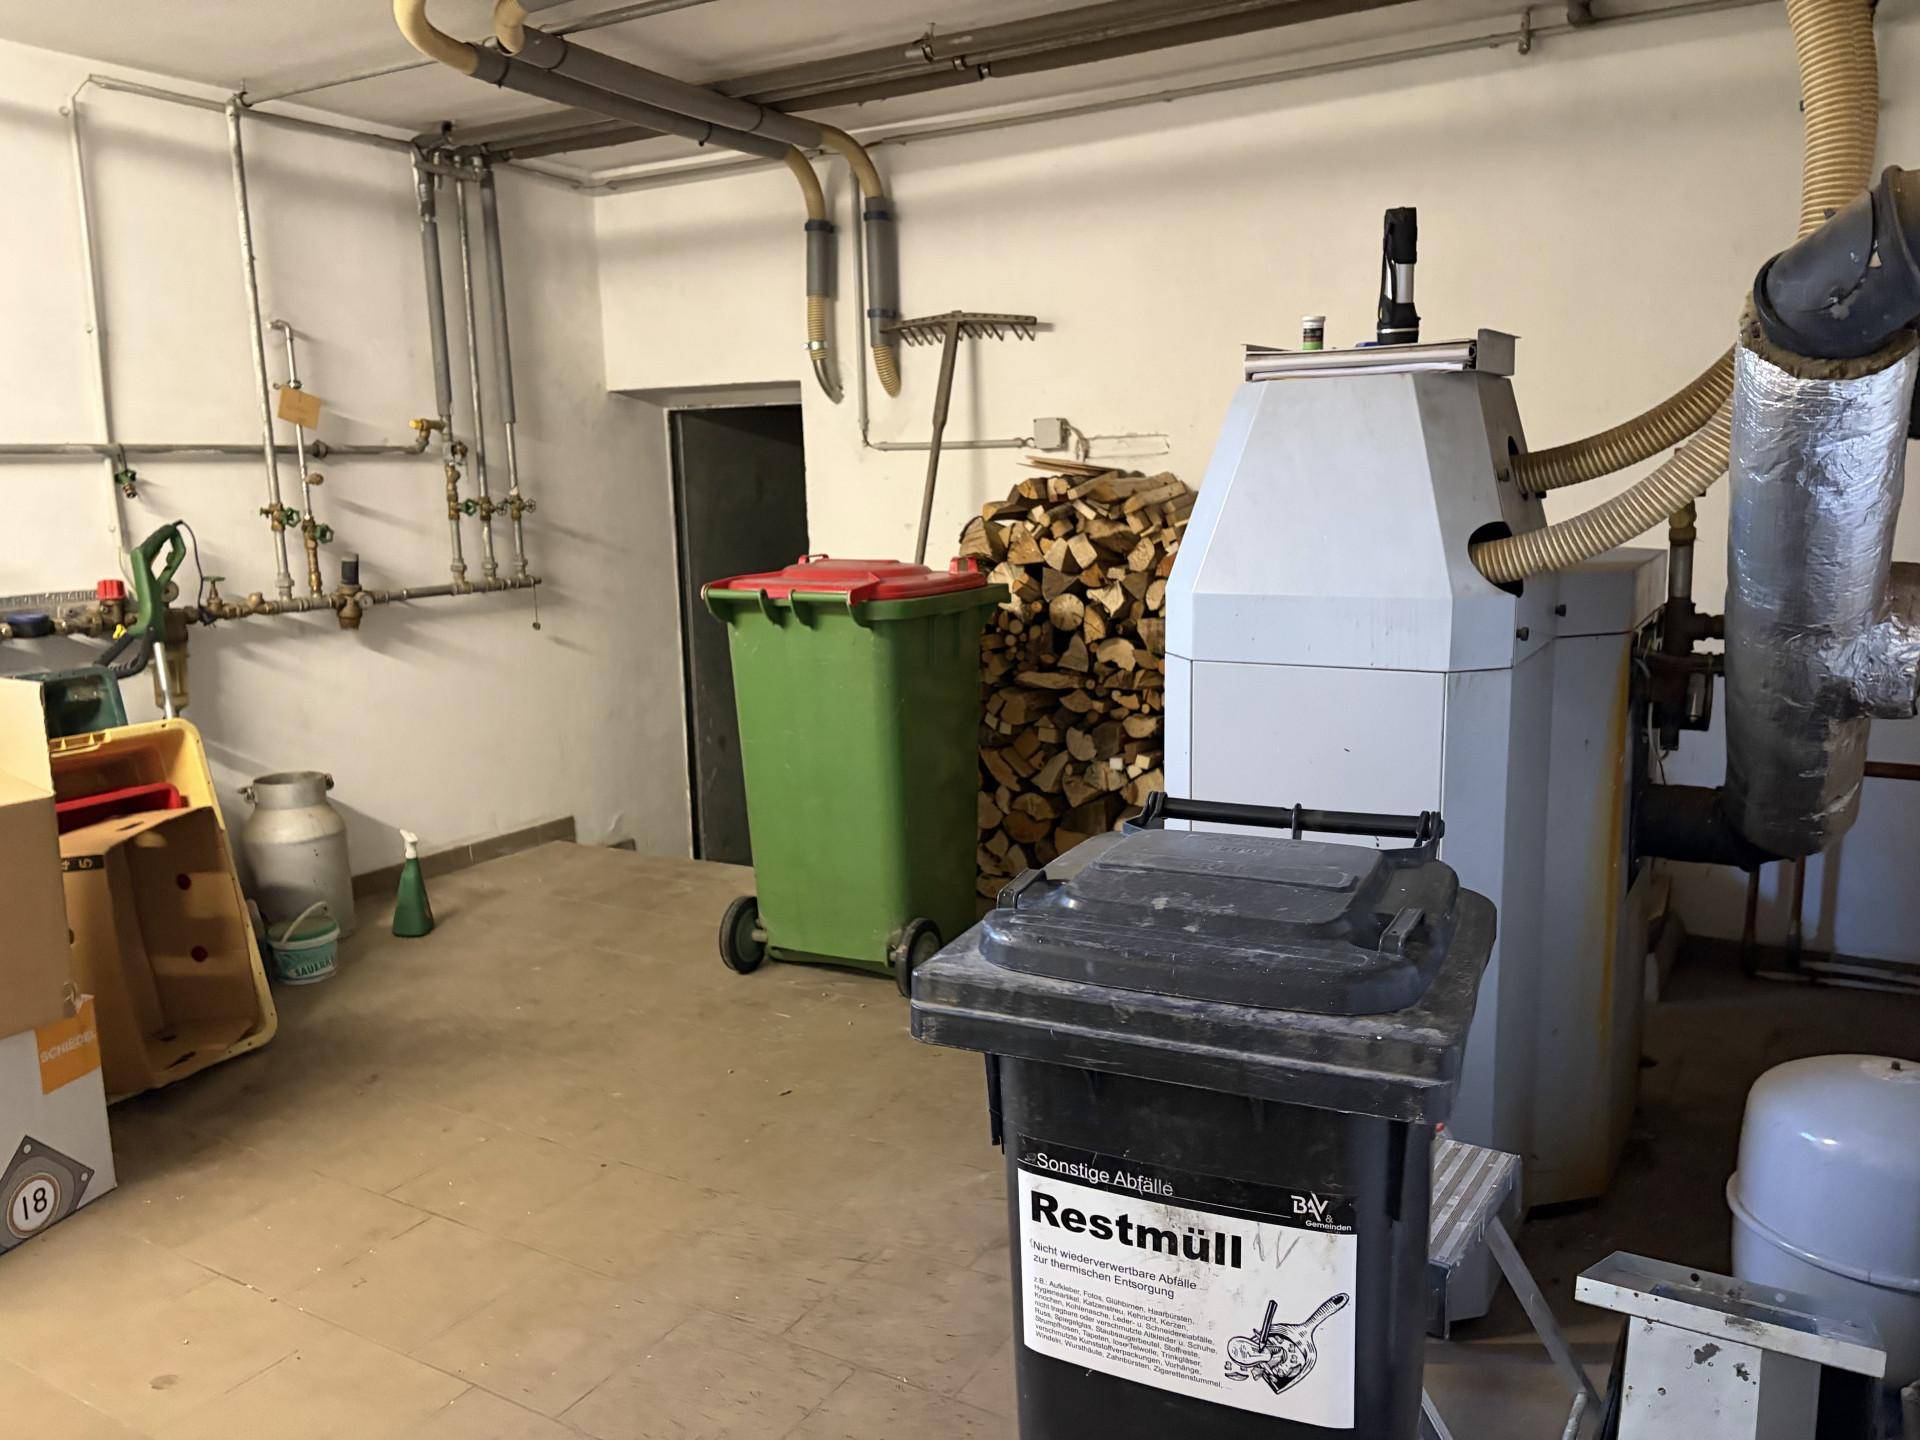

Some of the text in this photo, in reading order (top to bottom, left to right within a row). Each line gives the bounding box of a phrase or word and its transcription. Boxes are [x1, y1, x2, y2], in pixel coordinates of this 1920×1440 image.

[1037, 1152, 1174, 1196] Sonstige Abfälle
[23, 1187, 48, 1221] 18
[1290, 1190, 1329, 1222] BAV
[1325, 1214, 1334, 1224] &
[1030, 1189, 1242, 1269] Restmüll
[1305, 1219, 1352, 1231] Gemeinden
[1033, 1241, 1198, 1290] Nicht wiederverwertbare Abfälle
[1033, 1254, 1175, 1300] zur thermischen Entsorgung
